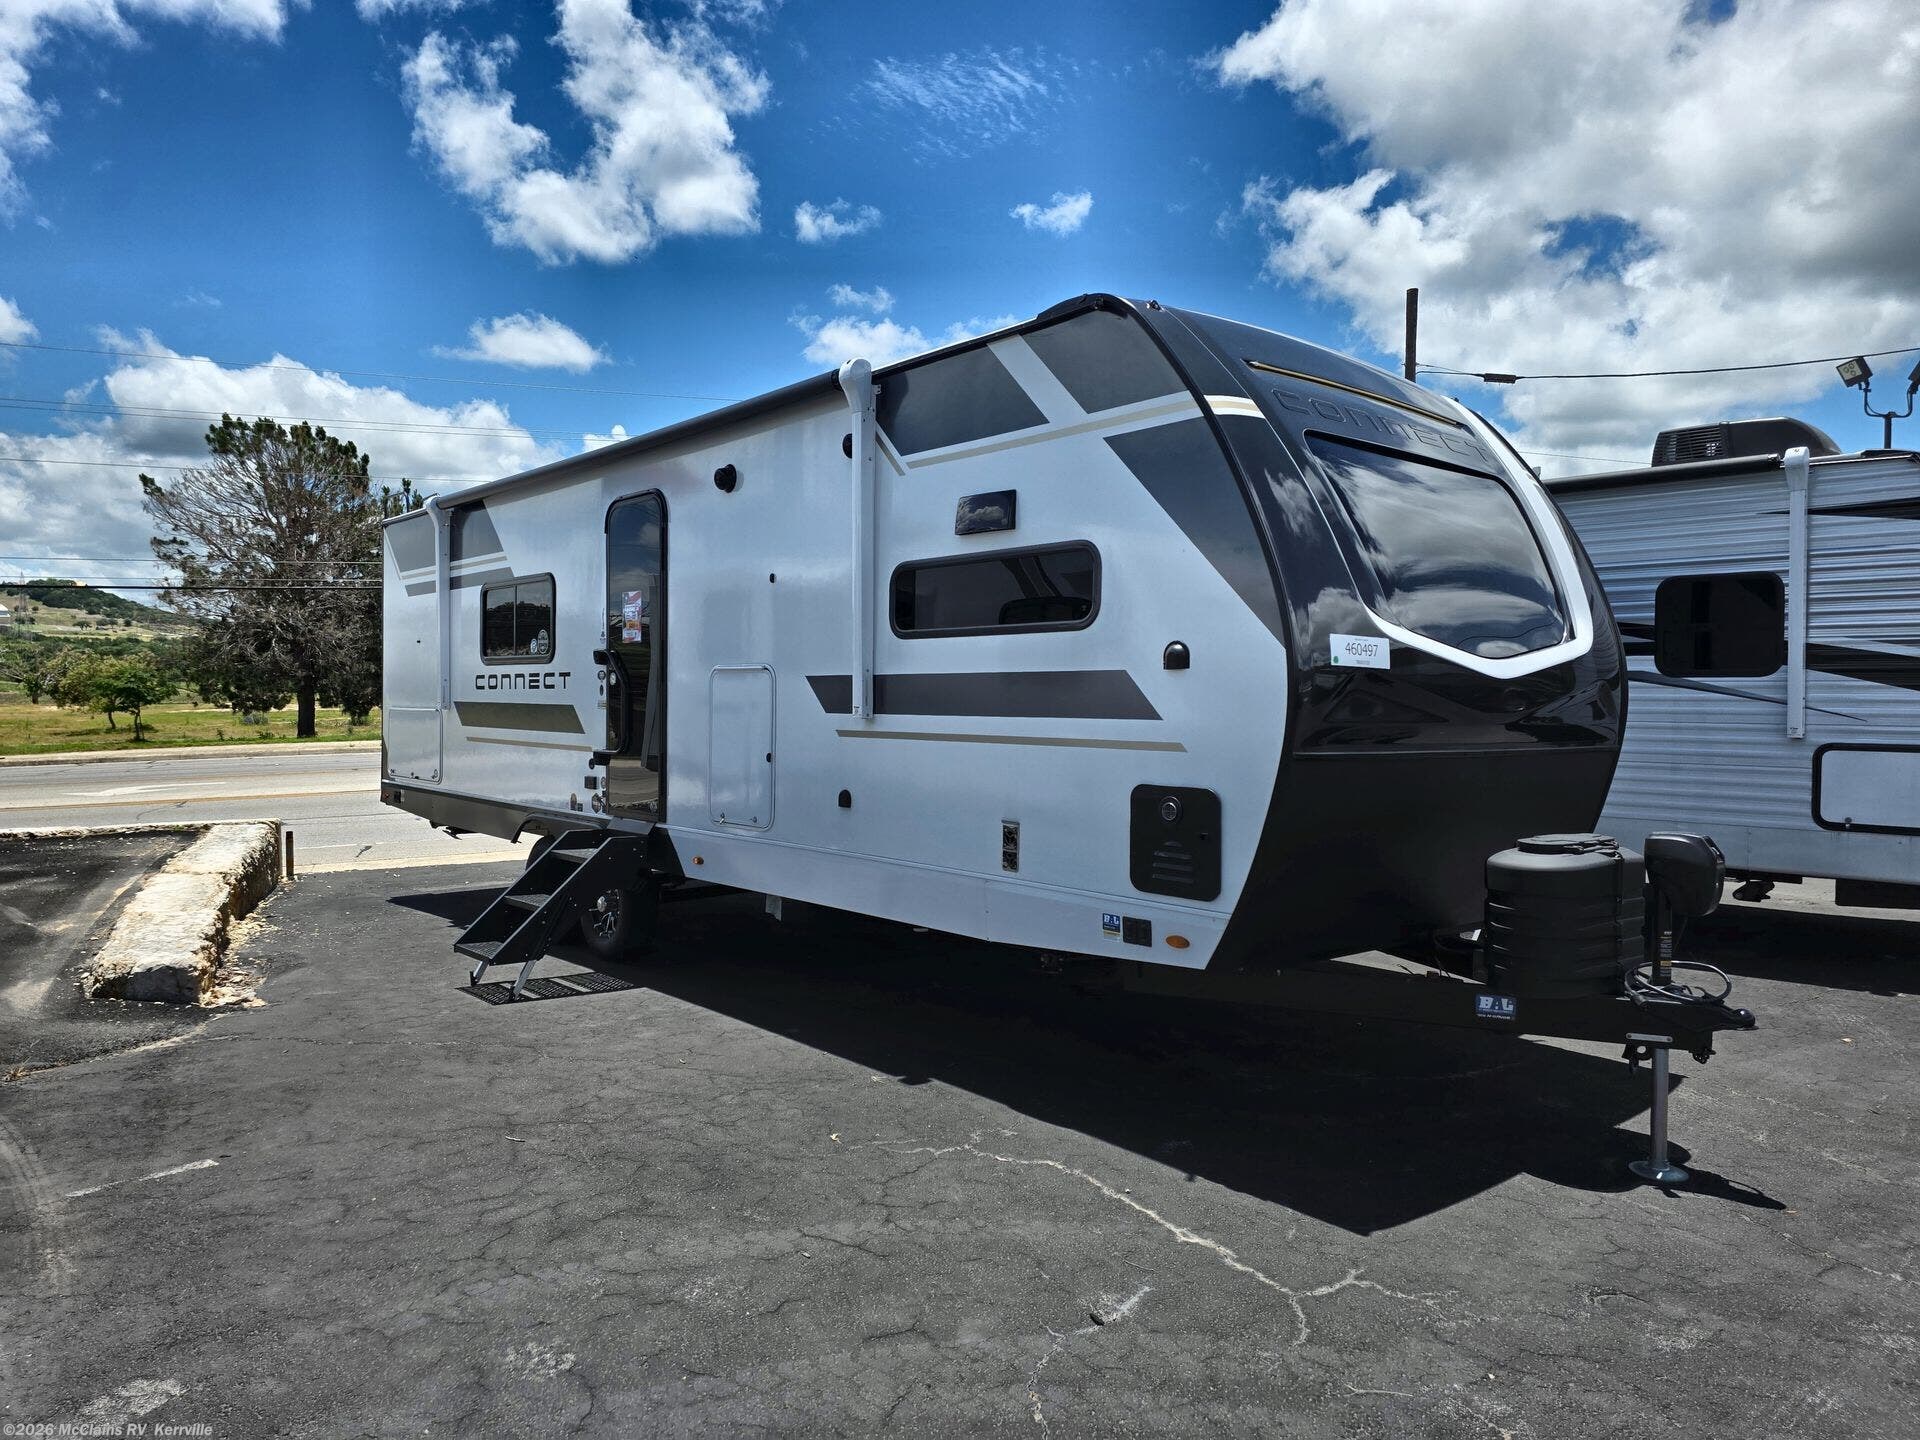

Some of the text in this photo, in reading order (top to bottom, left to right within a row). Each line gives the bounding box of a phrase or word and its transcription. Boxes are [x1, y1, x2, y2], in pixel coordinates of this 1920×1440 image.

[1271, 388, 1488, 463] CONNECT
[1344, 642, 1379, 657] 460497
[475, 672, 571, 690] CONNECT
